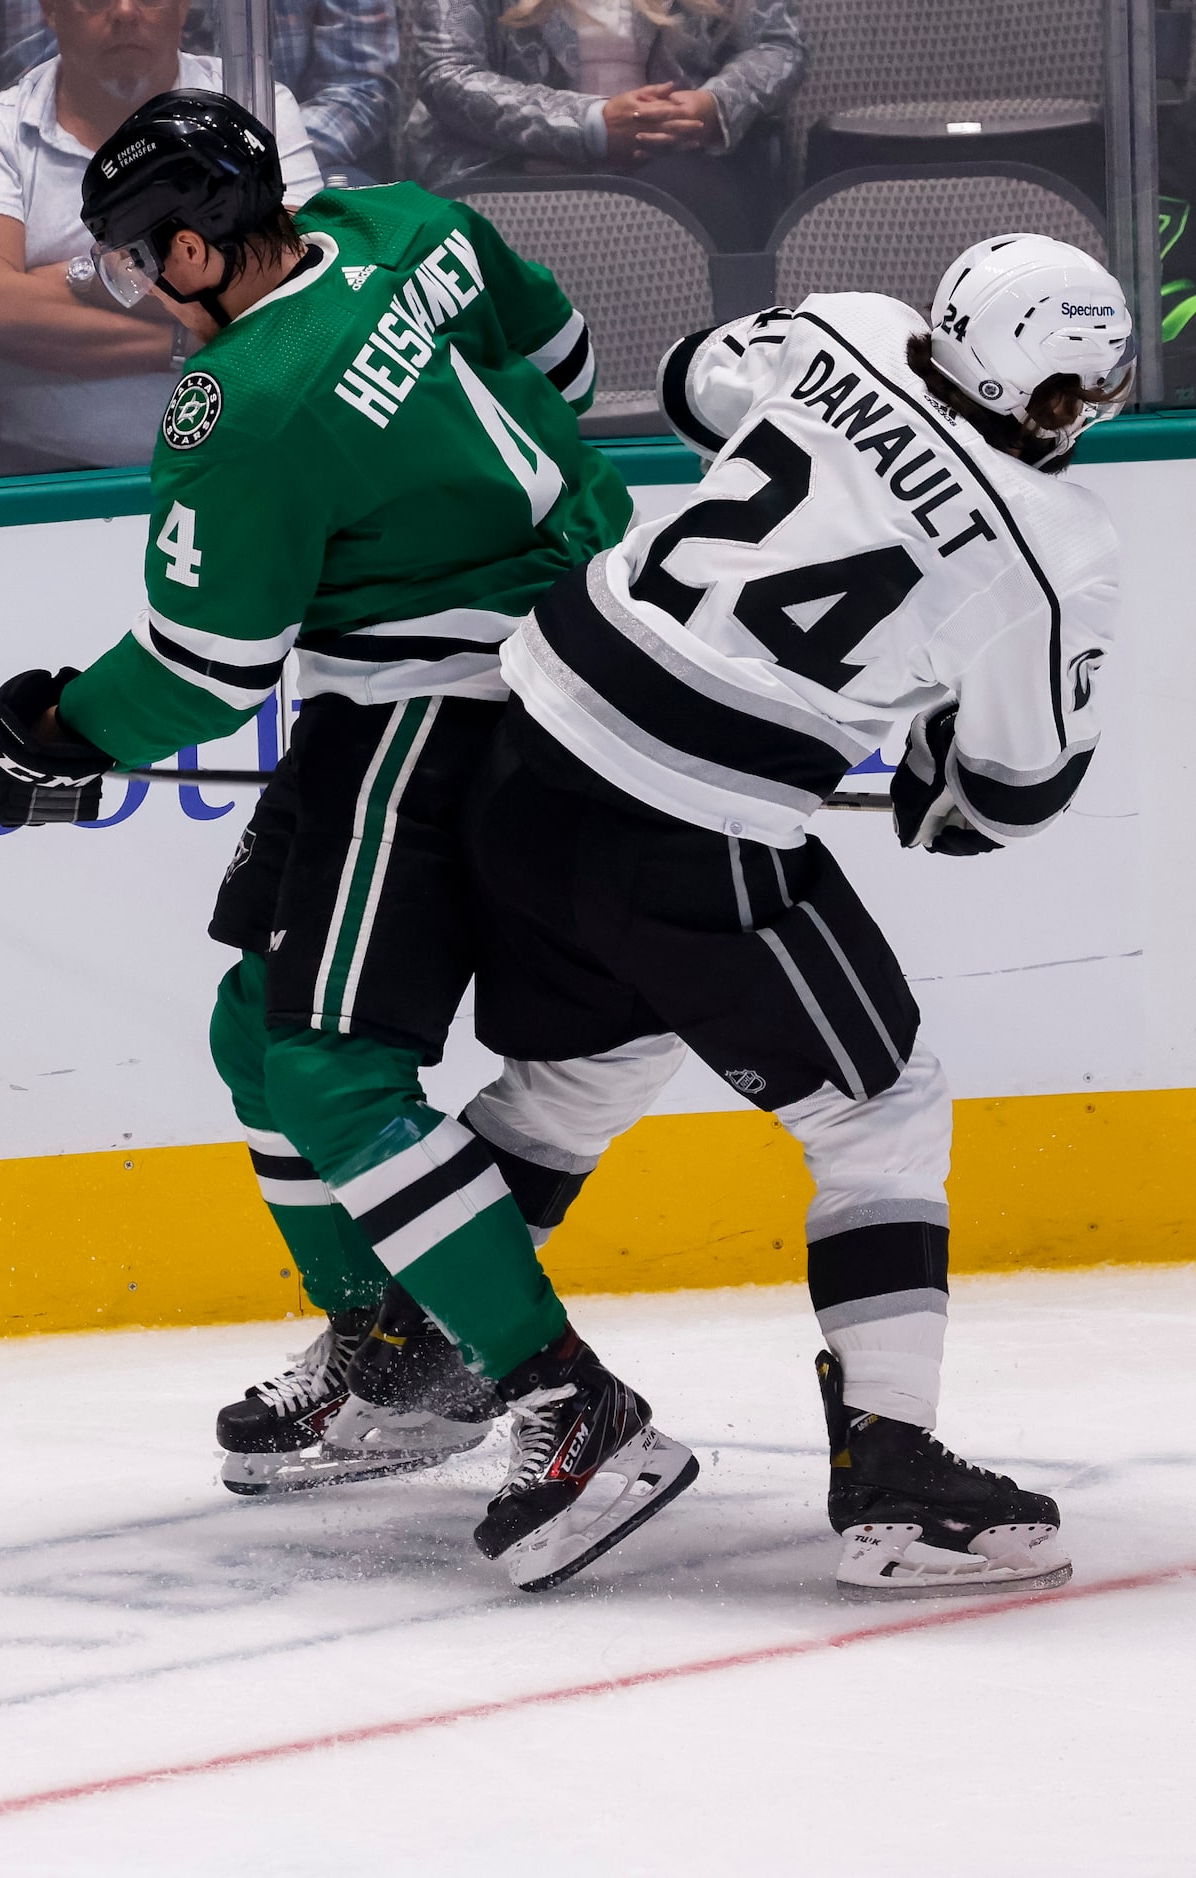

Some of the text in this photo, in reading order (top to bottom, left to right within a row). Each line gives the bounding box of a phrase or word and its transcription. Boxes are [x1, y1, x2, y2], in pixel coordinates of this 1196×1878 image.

[117, 138, 145, 161] ENERGY
[120, 142, 156, 168] TRANSFER
[352, 264, 377, 290] adidas
[940, 303, 970, 342] 24
[1061, 302, 1113, 319] Spectrum
[170, 377, 218, 409] DALLAS
[166, 420, 210, 444] STARS
[791, 350, 997, 558] DANAULT
[156, 500, 202, 587] 4
[629, 418, 924, 692] 24
[562, 1422, 589, 1473] CCM
